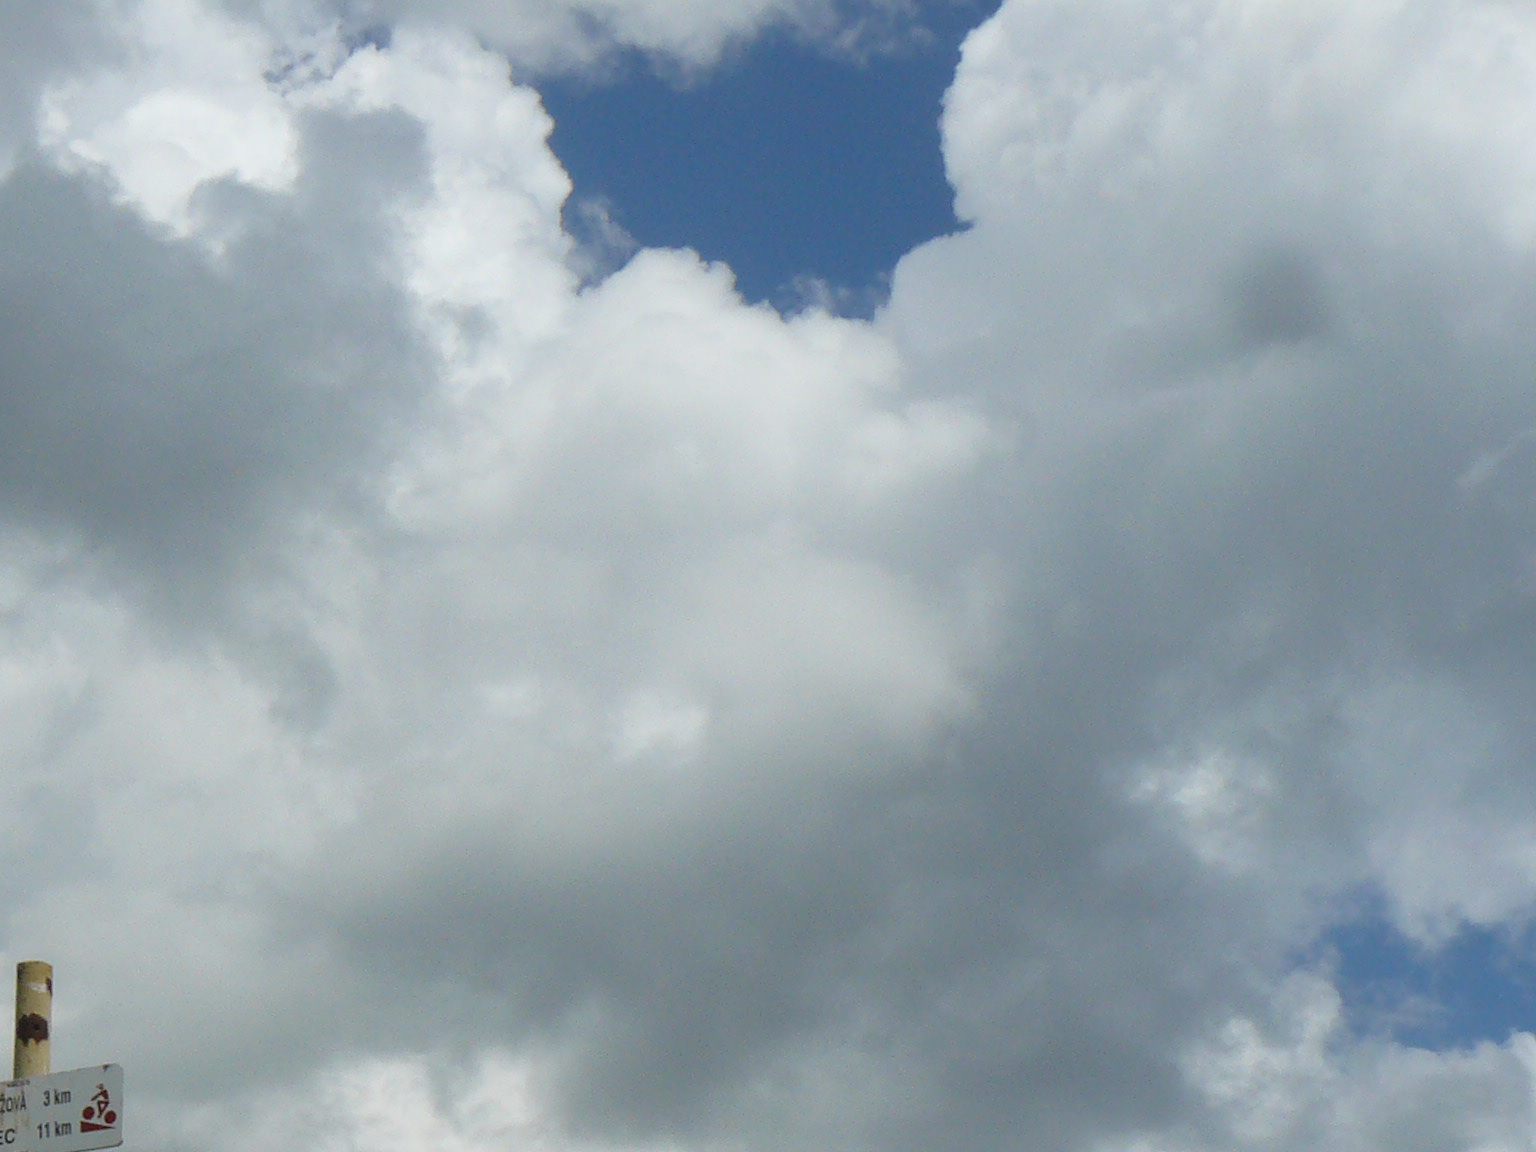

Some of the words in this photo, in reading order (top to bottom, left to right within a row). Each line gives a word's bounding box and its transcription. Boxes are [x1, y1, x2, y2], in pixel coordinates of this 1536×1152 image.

[43, 1090, 51, 1108] 3
[53, 1088, 72, 1106] km
[37, 1122, 50, 1140] 11
[54, 1120, 73, 1138] km
